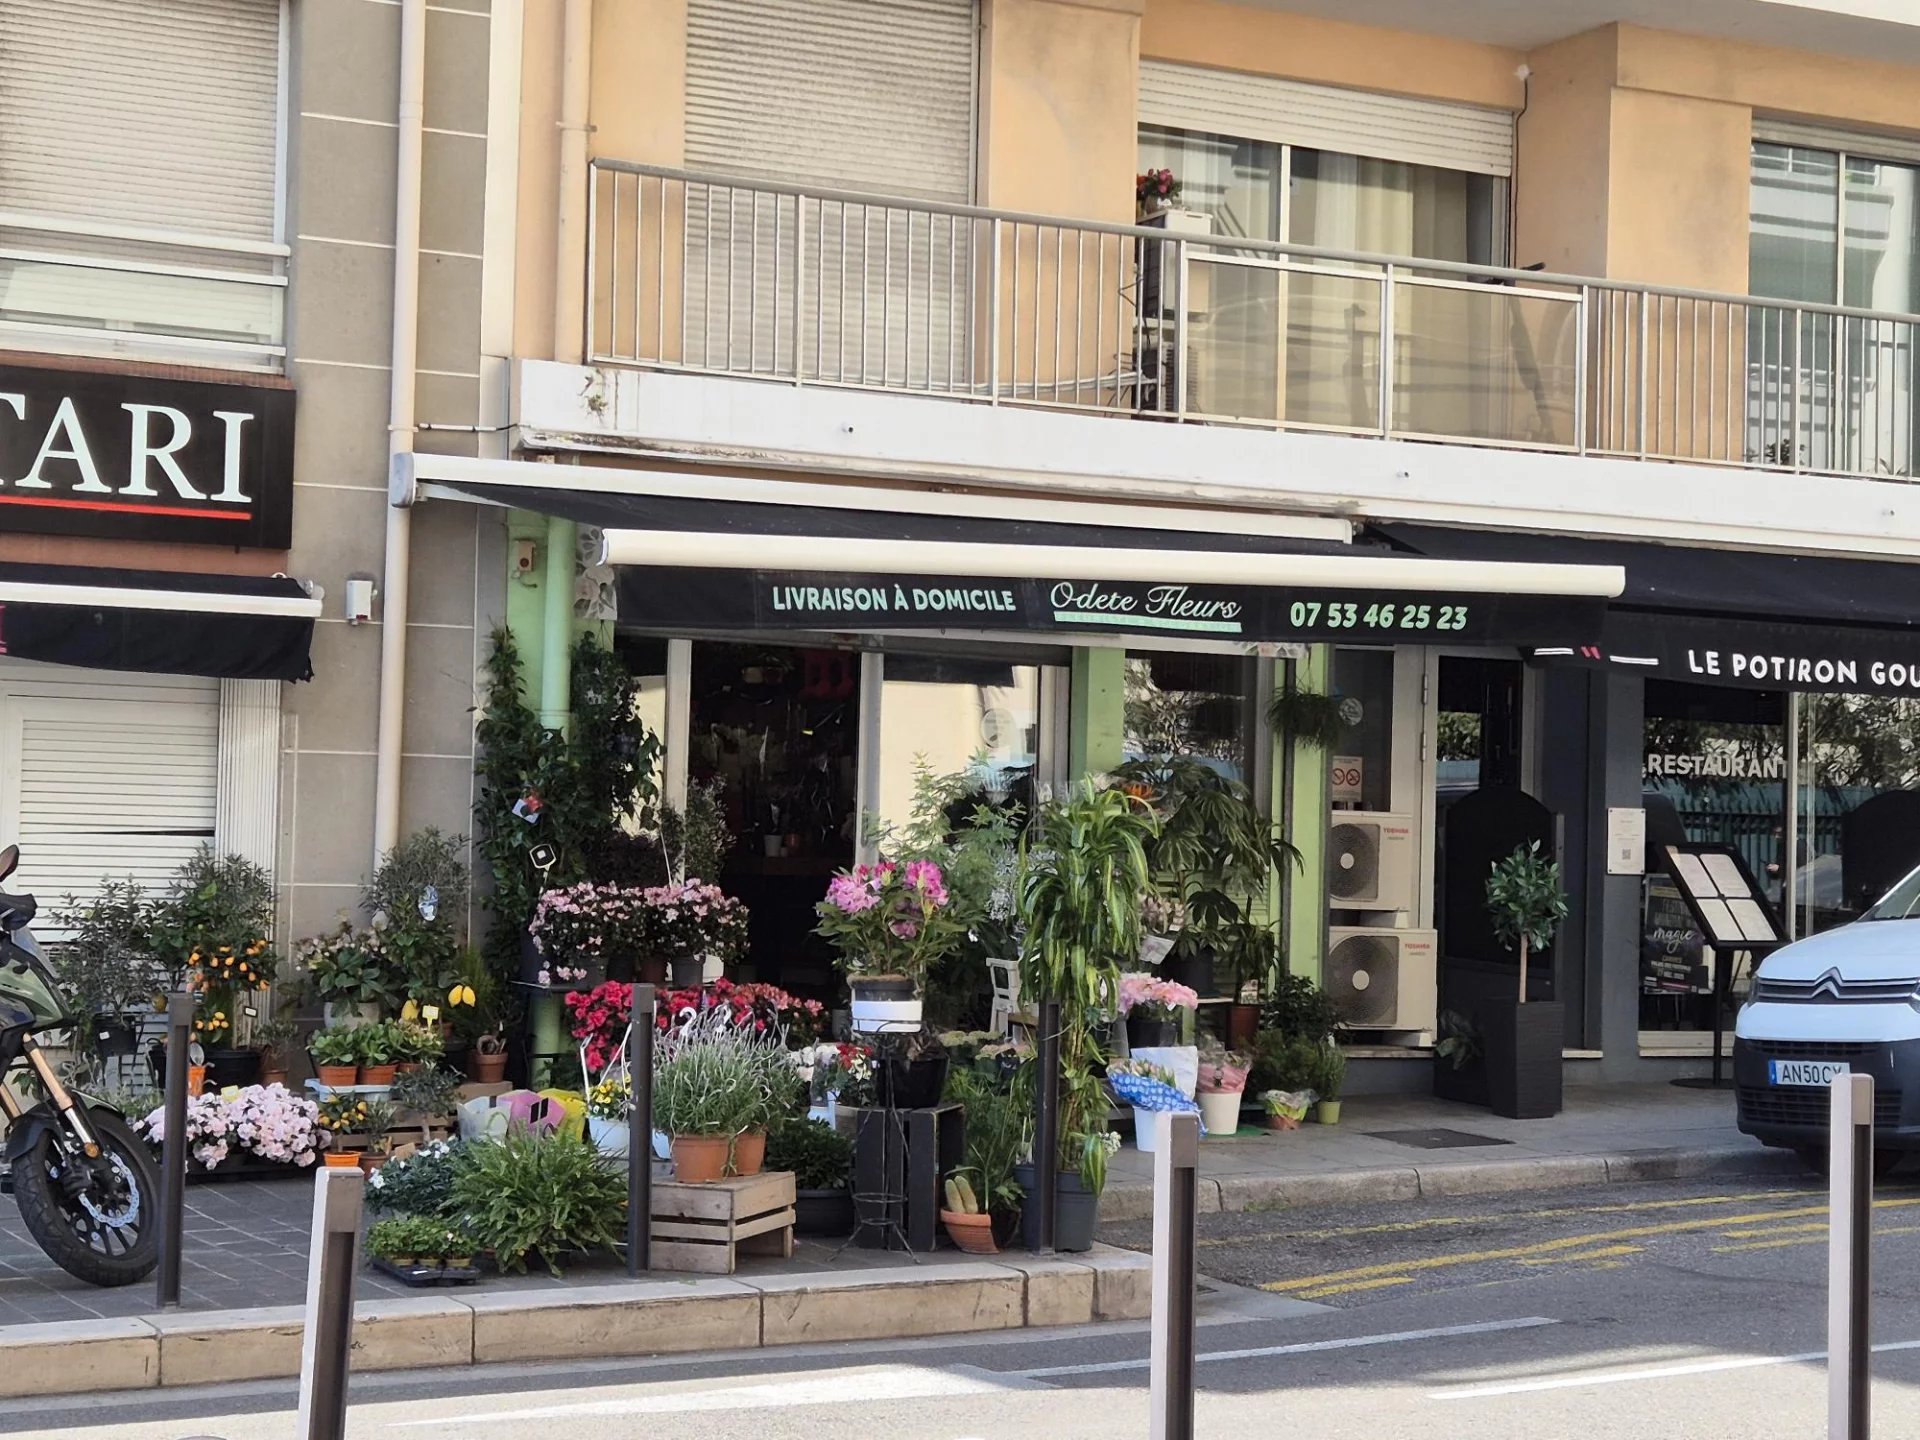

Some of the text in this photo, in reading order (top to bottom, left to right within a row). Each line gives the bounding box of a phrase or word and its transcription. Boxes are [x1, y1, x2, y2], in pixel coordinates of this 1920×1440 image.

[773, 583, 1017, 611] LIVRAISON À DOMICILE
[1050, 582, 1242, 619] Odete Fleurs
[1290, 602, 1468, 630] 07 53 46 25 23
[1688, 649, 1721, 675] LE
[1732, 653, 1857, 684] POTIRON
